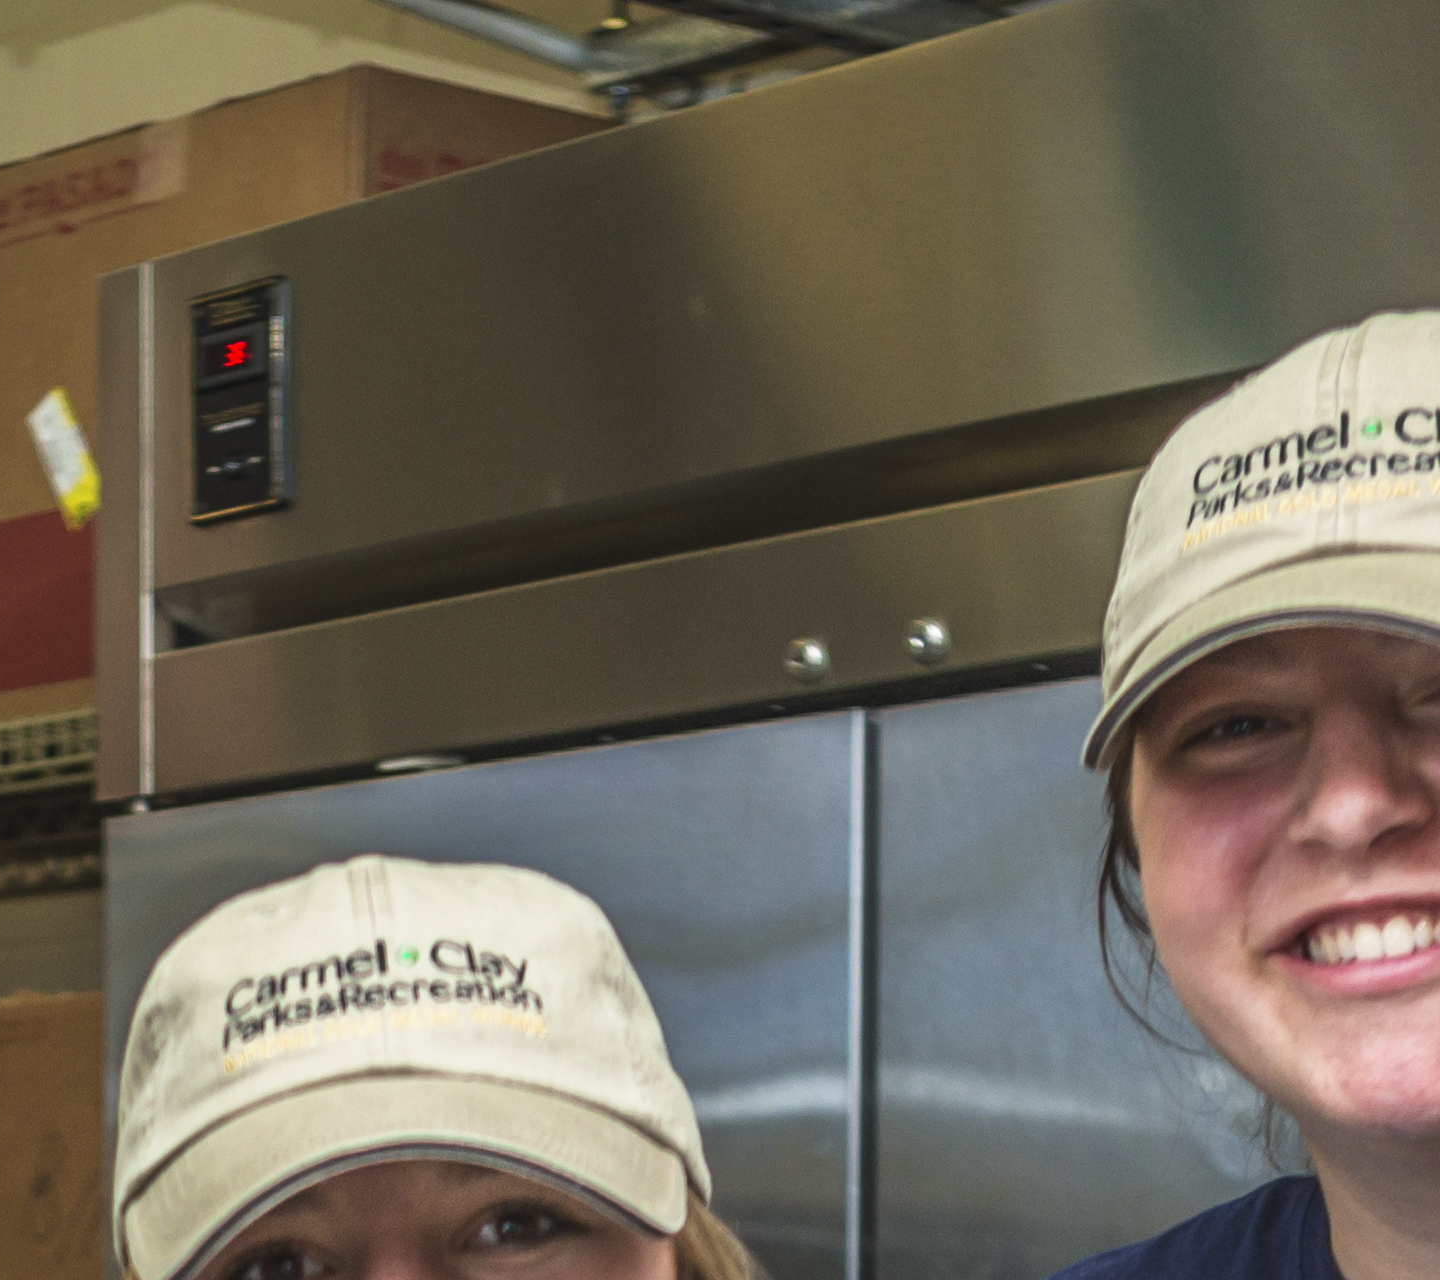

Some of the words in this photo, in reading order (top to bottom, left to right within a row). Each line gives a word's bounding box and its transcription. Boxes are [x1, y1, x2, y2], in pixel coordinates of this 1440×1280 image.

[1192, 408, 1350, 496] Carmel
[221, 977, 544, 1054] Parks&Recreation
[223, 937, 388, 1018] Carmel
[428, 936, 528, 986] Clay
